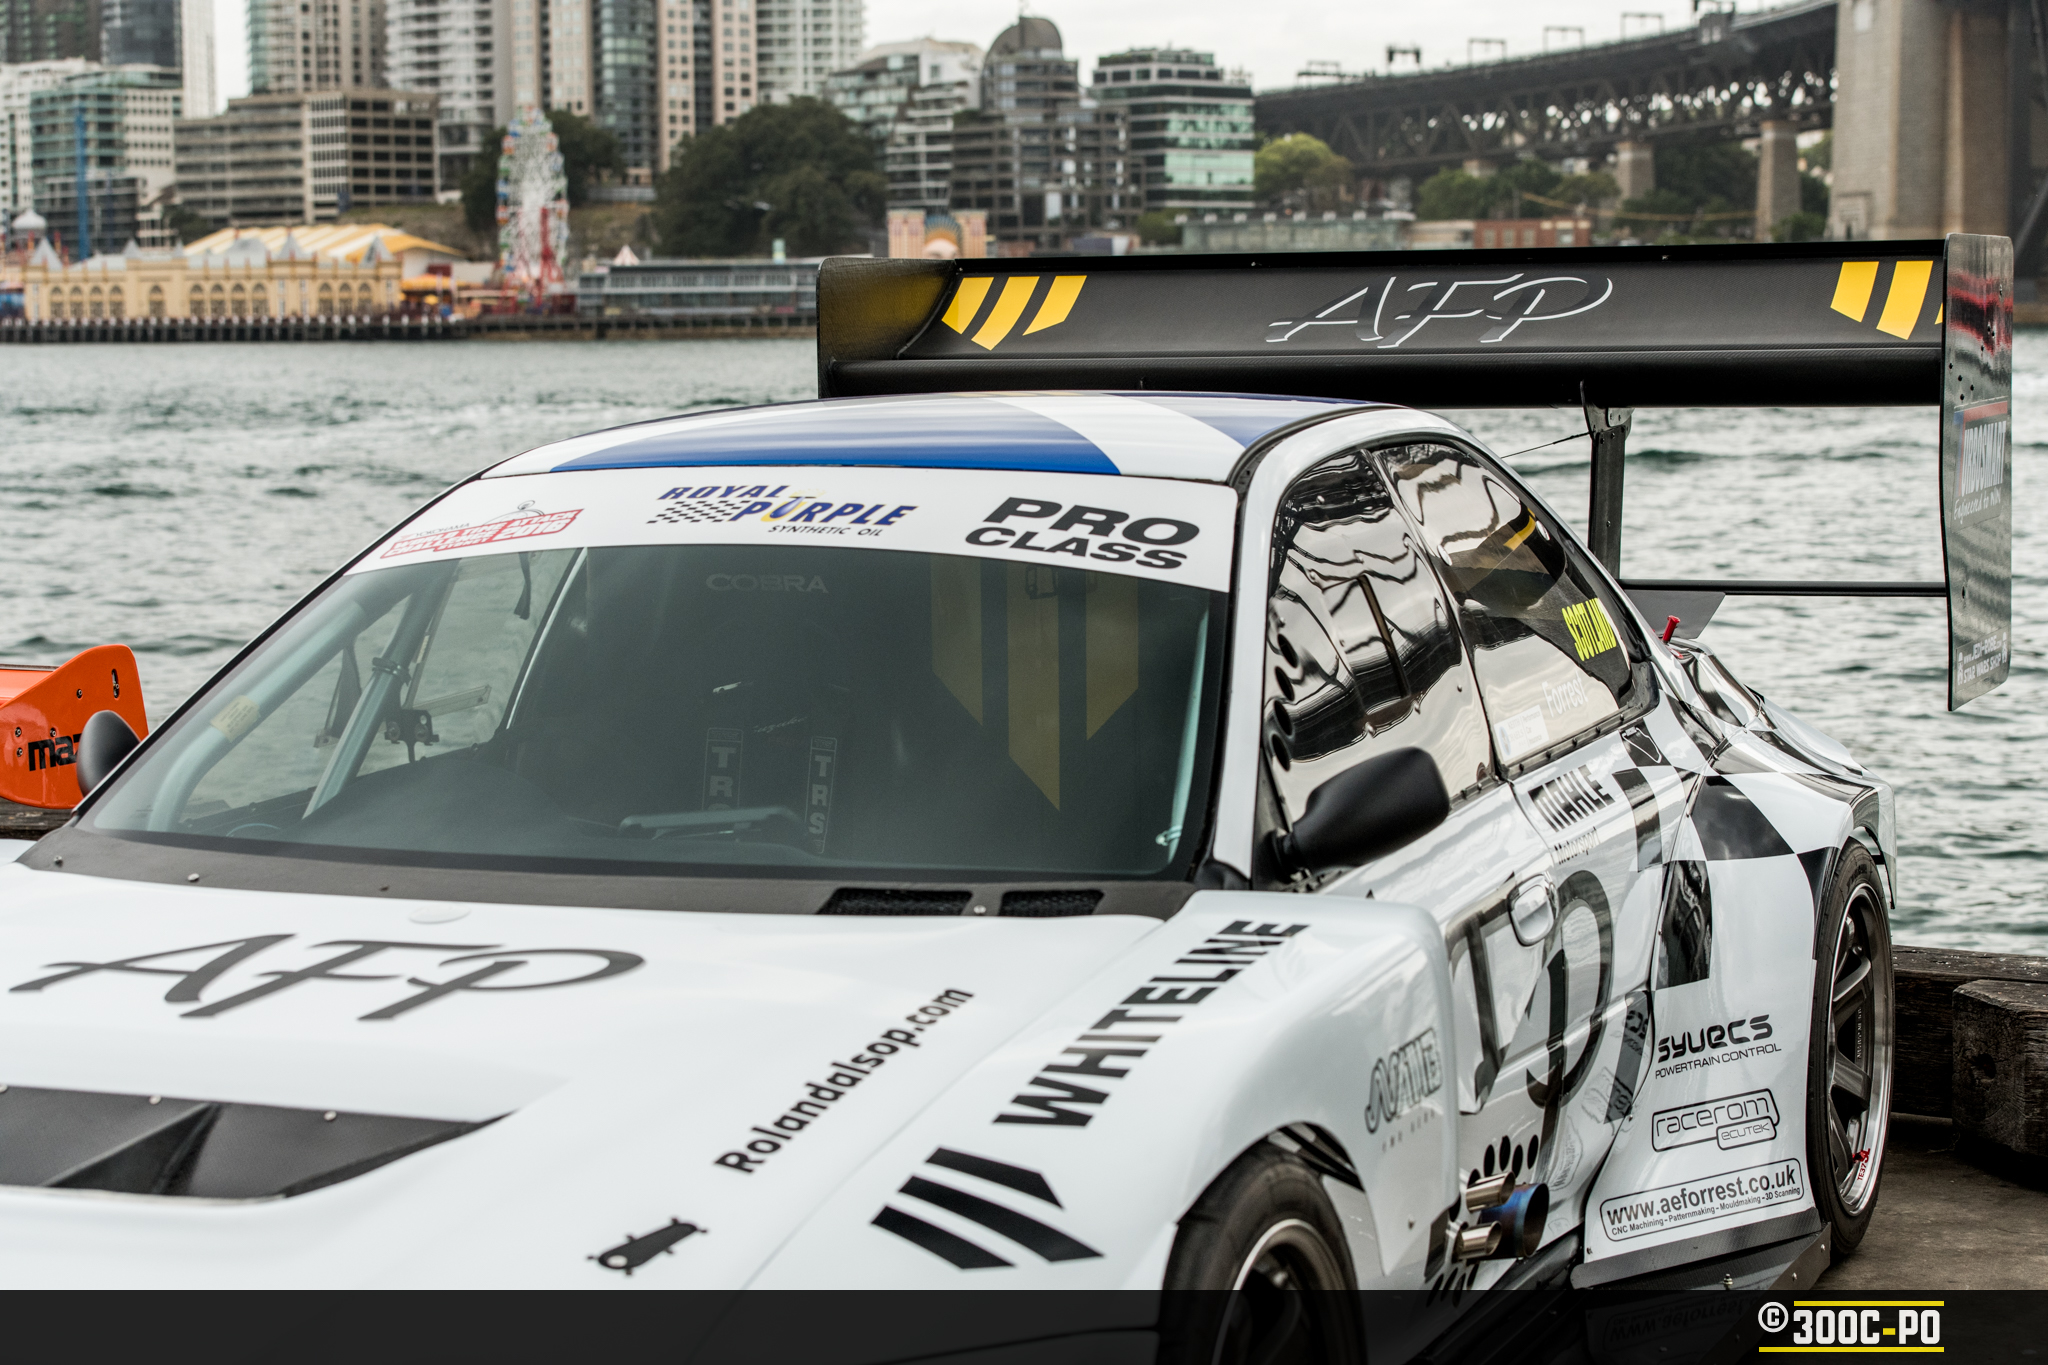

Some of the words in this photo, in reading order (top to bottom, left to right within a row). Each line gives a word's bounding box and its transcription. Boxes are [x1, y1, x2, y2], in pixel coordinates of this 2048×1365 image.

[1264, 272, 1614, 349] AFP
[657, 485, 791, 501] ROYAL
[727, 498, 919, 526] PURPLE
[508, 510, 579, 527] ATTACK
[768, 525, 851, 535] SYNTHETIC
[857, 528, 884, 537] OIL
[983, 497, 1200, 546] PRO
[965, 526, 1188, 570] CLASS
[705, 573, 829, 594] COBRA
[1561, 597, 1617, 661] SCOTLAND
[1541, 670, 1589, 717] Forrest
[1528, 764, 1616, 832] MAHLE
[1554, 826, 1601, 865] Motorsport
[8, 934, 646, 1021] AFP
[992, 920, 1311, 1127] WHITELINE
[713, 988, 975, 1174] Rolandalsop.com
[1655, 1055, 1720, 1079] POWERTRAIN
[1721, 1043, 1782, 1063] CONTROL
[1656, 1097, 1770, 1137] racerom
[1607, 1165, 1796, 1226] www.aeforrest.co.uk
[1611, 1225, 1628, 1236] CNC
[1630, 1218, 1665, 1232] Machining
[1668, 1207, 1715, 1223] Patternmaking
[1719, 1195, 1761, 1211] Mouldmaking
[1774, 1187, 1801, 1199] Scanning
